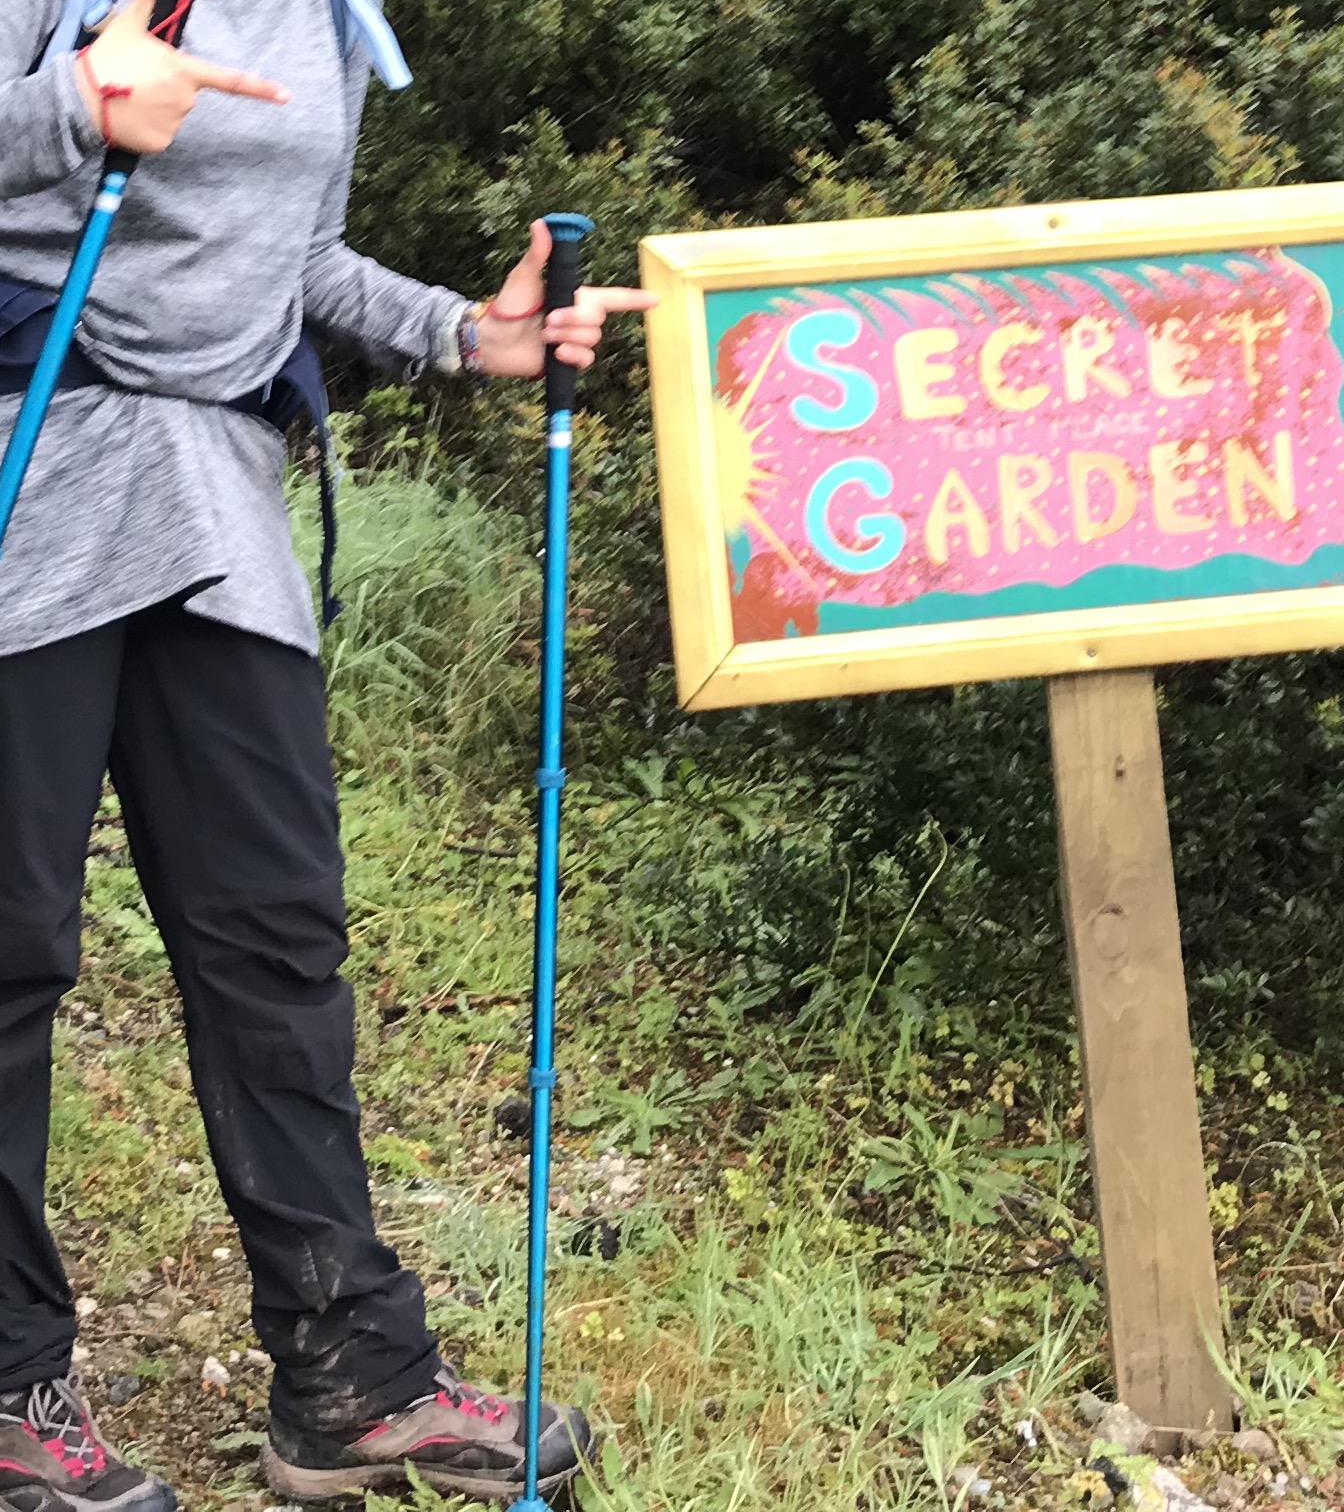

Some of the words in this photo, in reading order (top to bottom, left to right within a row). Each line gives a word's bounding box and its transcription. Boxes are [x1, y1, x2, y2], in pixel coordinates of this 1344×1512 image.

[785, 306, 1289, 433] SECRET
[931, 421, 1020, 452] TENT
[803, 429, 1296, 576] GARDEN
